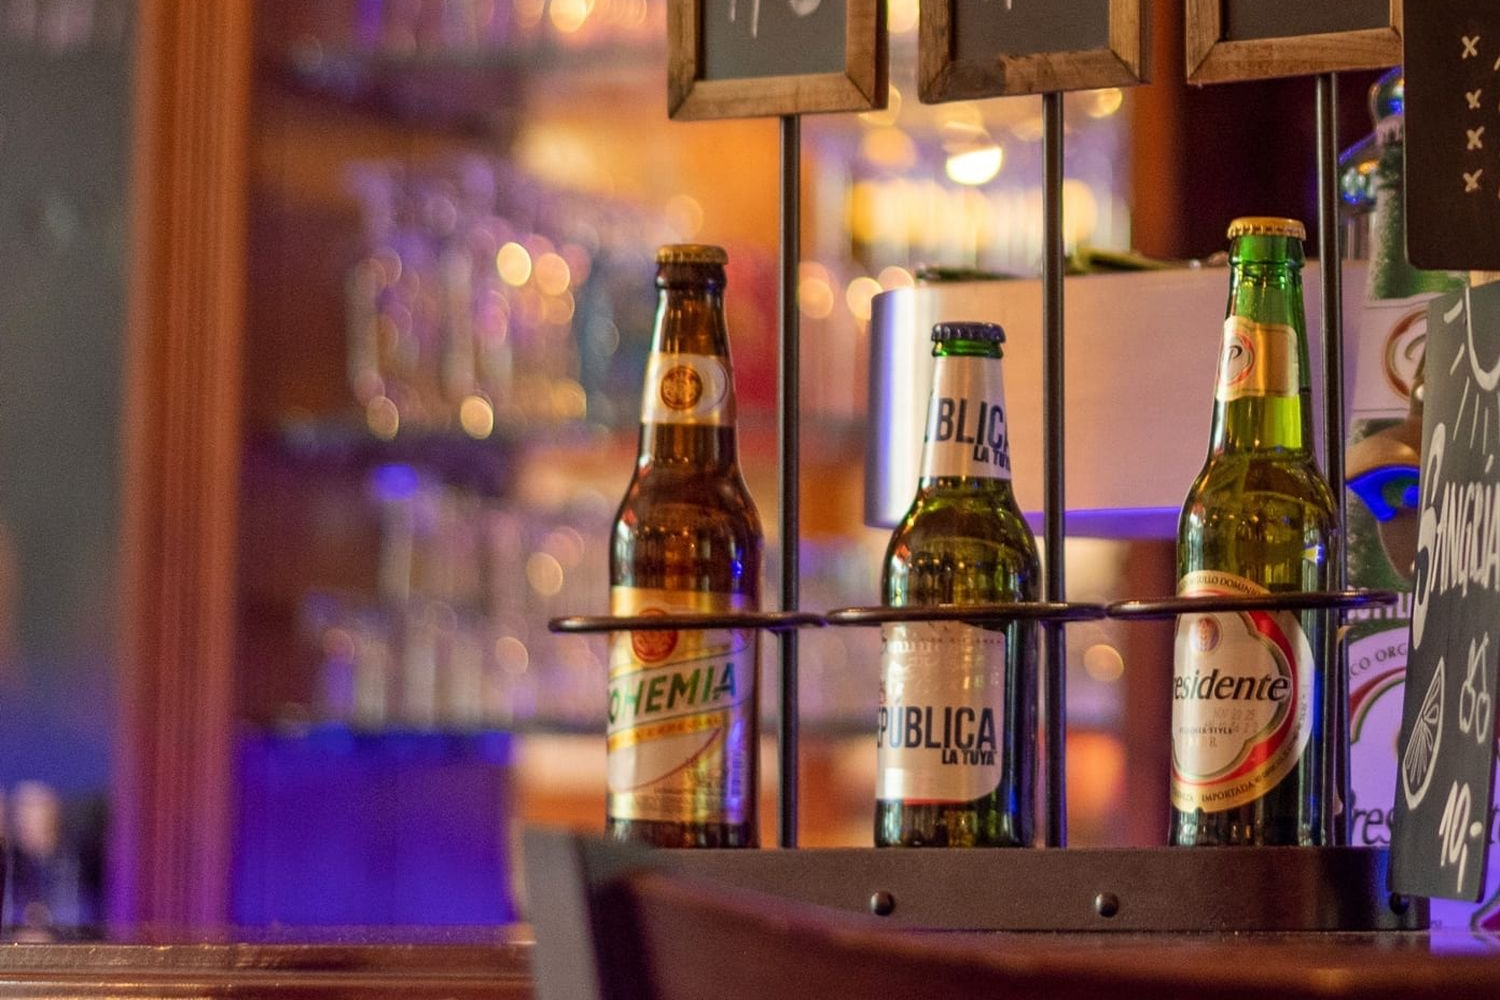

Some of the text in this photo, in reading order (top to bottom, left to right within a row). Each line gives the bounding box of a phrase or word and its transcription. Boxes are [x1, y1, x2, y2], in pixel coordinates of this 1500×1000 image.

[925, 391, 1008, 451] BLIC
[1174, 667, 1289, 702] esidente
[877, 705, 997, 750] PUBLICA
[941, 750, 959, 766] LA
